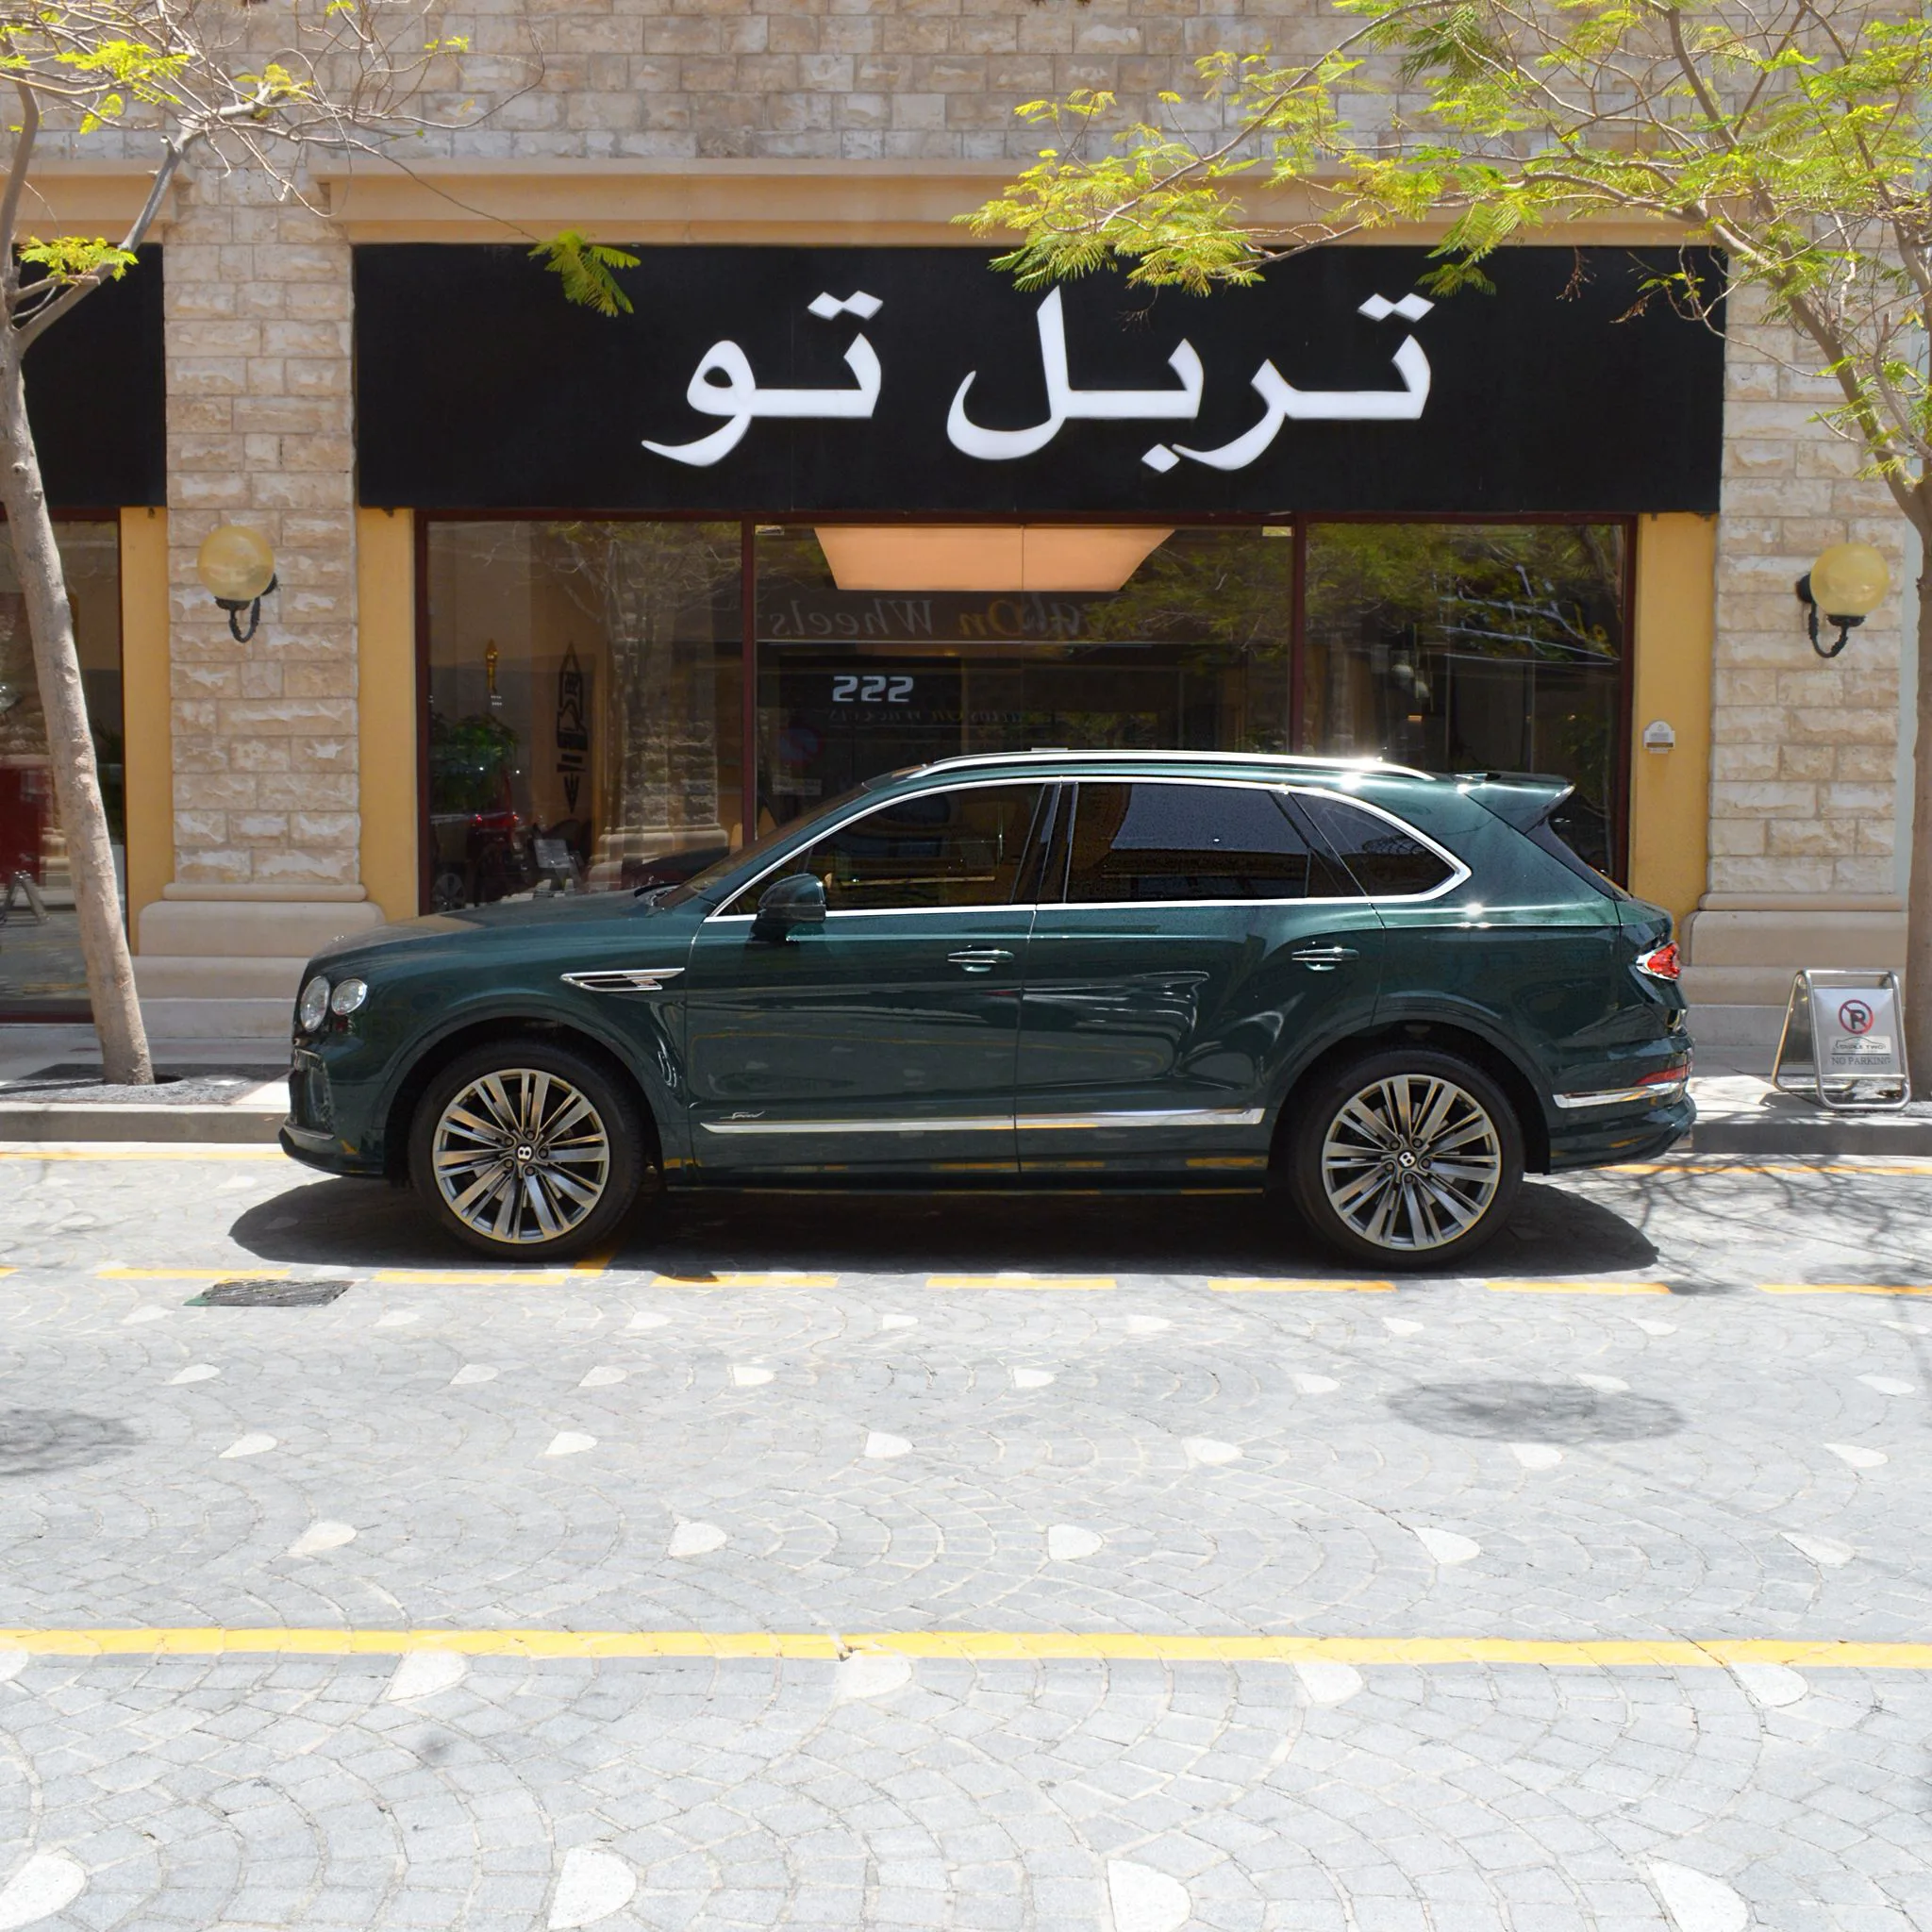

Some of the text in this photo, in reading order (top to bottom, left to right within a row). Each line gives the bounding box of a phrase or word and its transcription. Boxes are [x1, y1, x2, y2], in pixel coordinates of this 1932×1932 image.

[641, 285, 1435, 473] تربل تو
[832, 675, 914, 703] 222
[1832, 1057, 1891, 1066] NO PARKING
